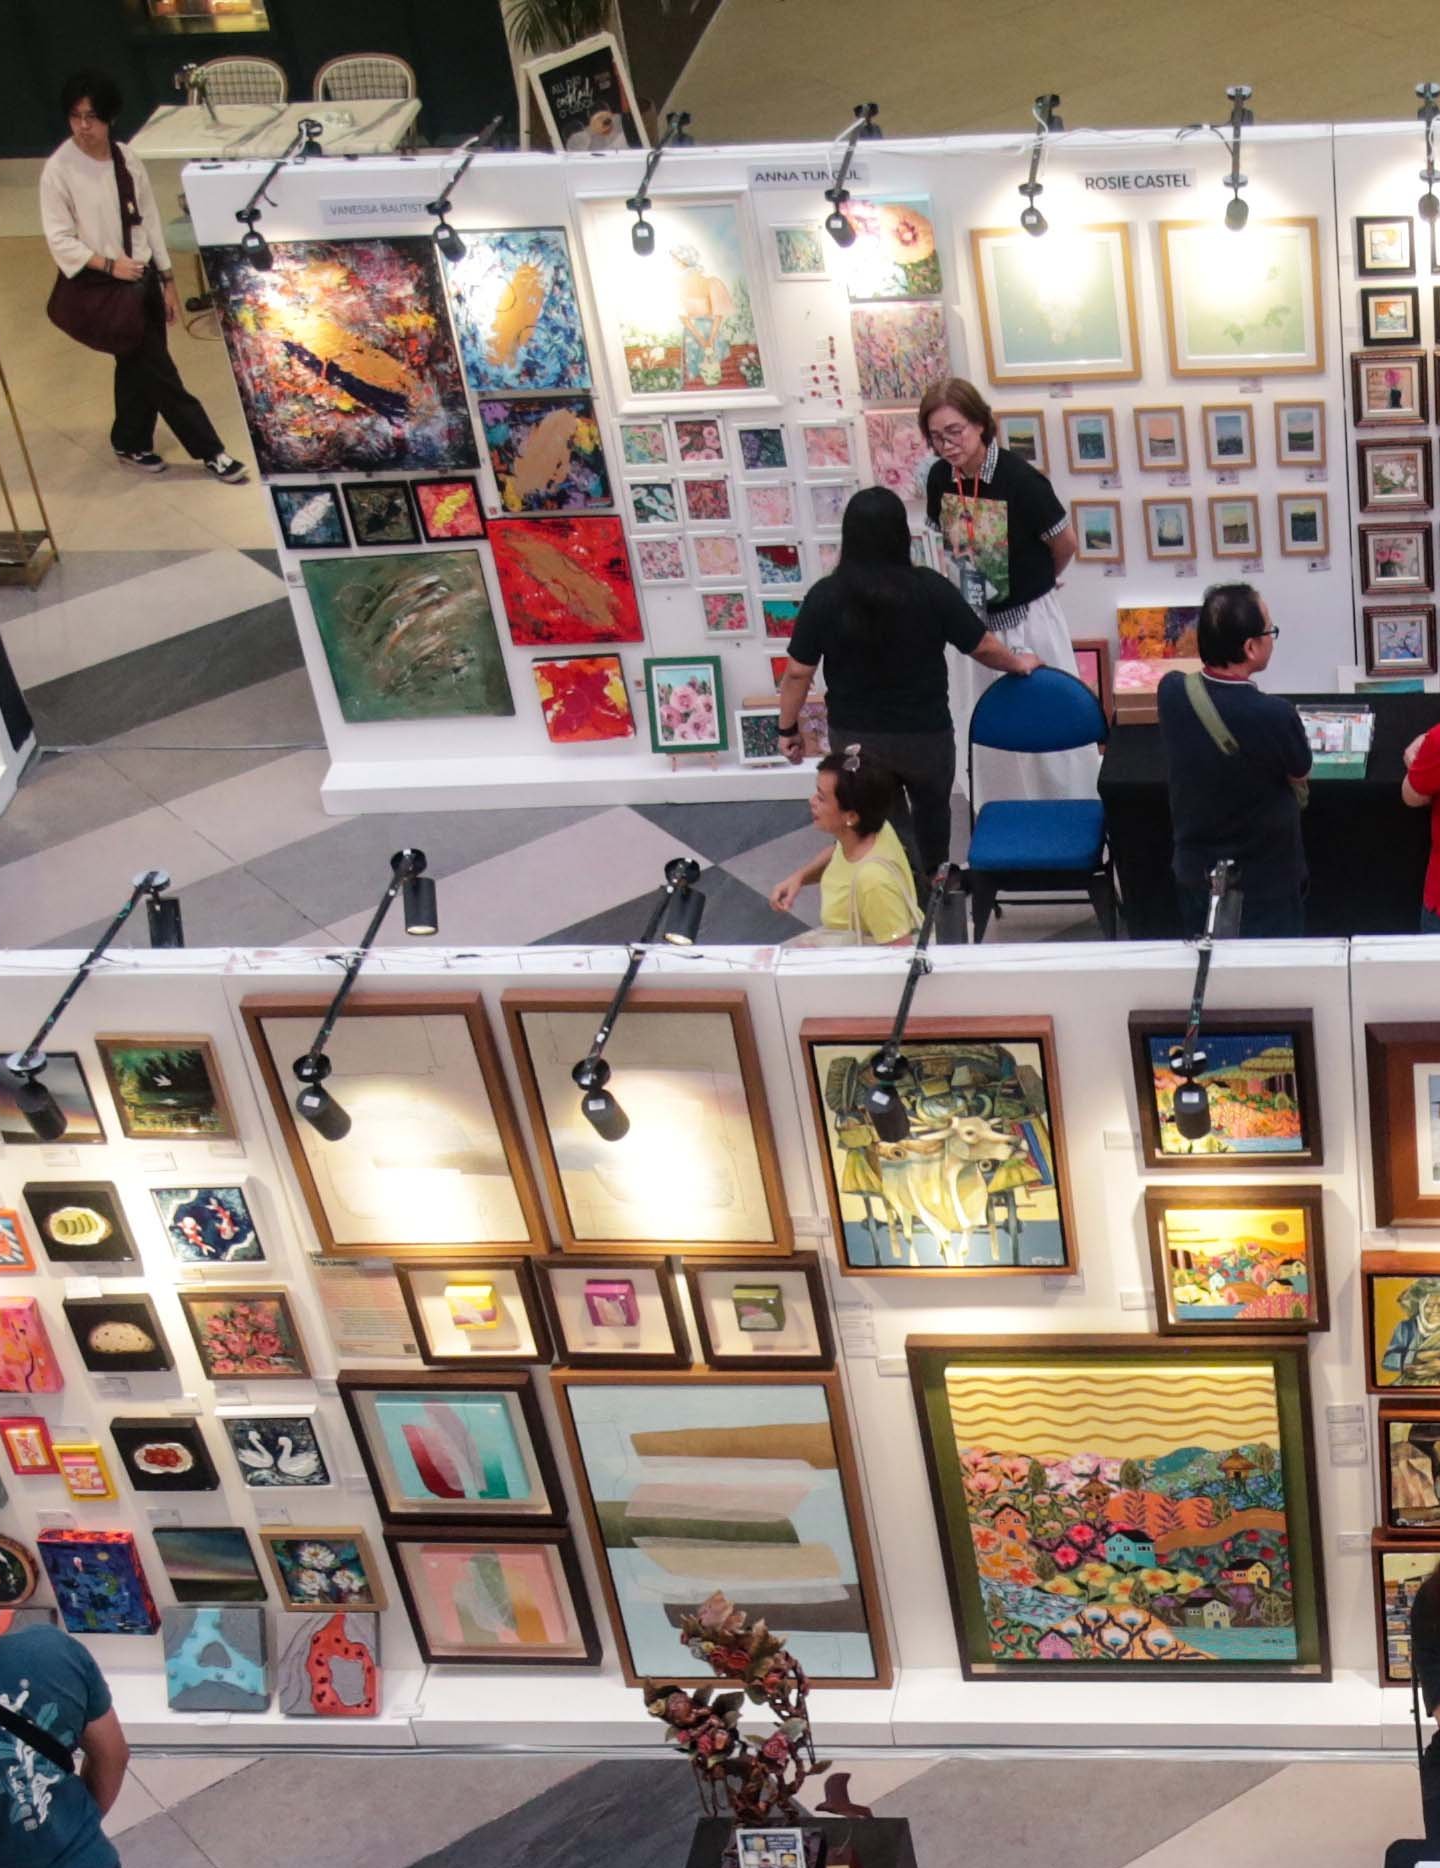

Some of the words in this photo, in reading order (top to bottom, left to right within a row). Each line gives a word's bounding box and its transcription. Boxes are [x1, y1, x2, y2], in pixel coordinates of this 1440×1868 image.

[754, 170, 799, 183] ANNA
[1085, 176, 1131, 190] ROSIE
[1134, 174, 1190, 189] CASTEL
[330, 203, 378, 216] VANESSA
